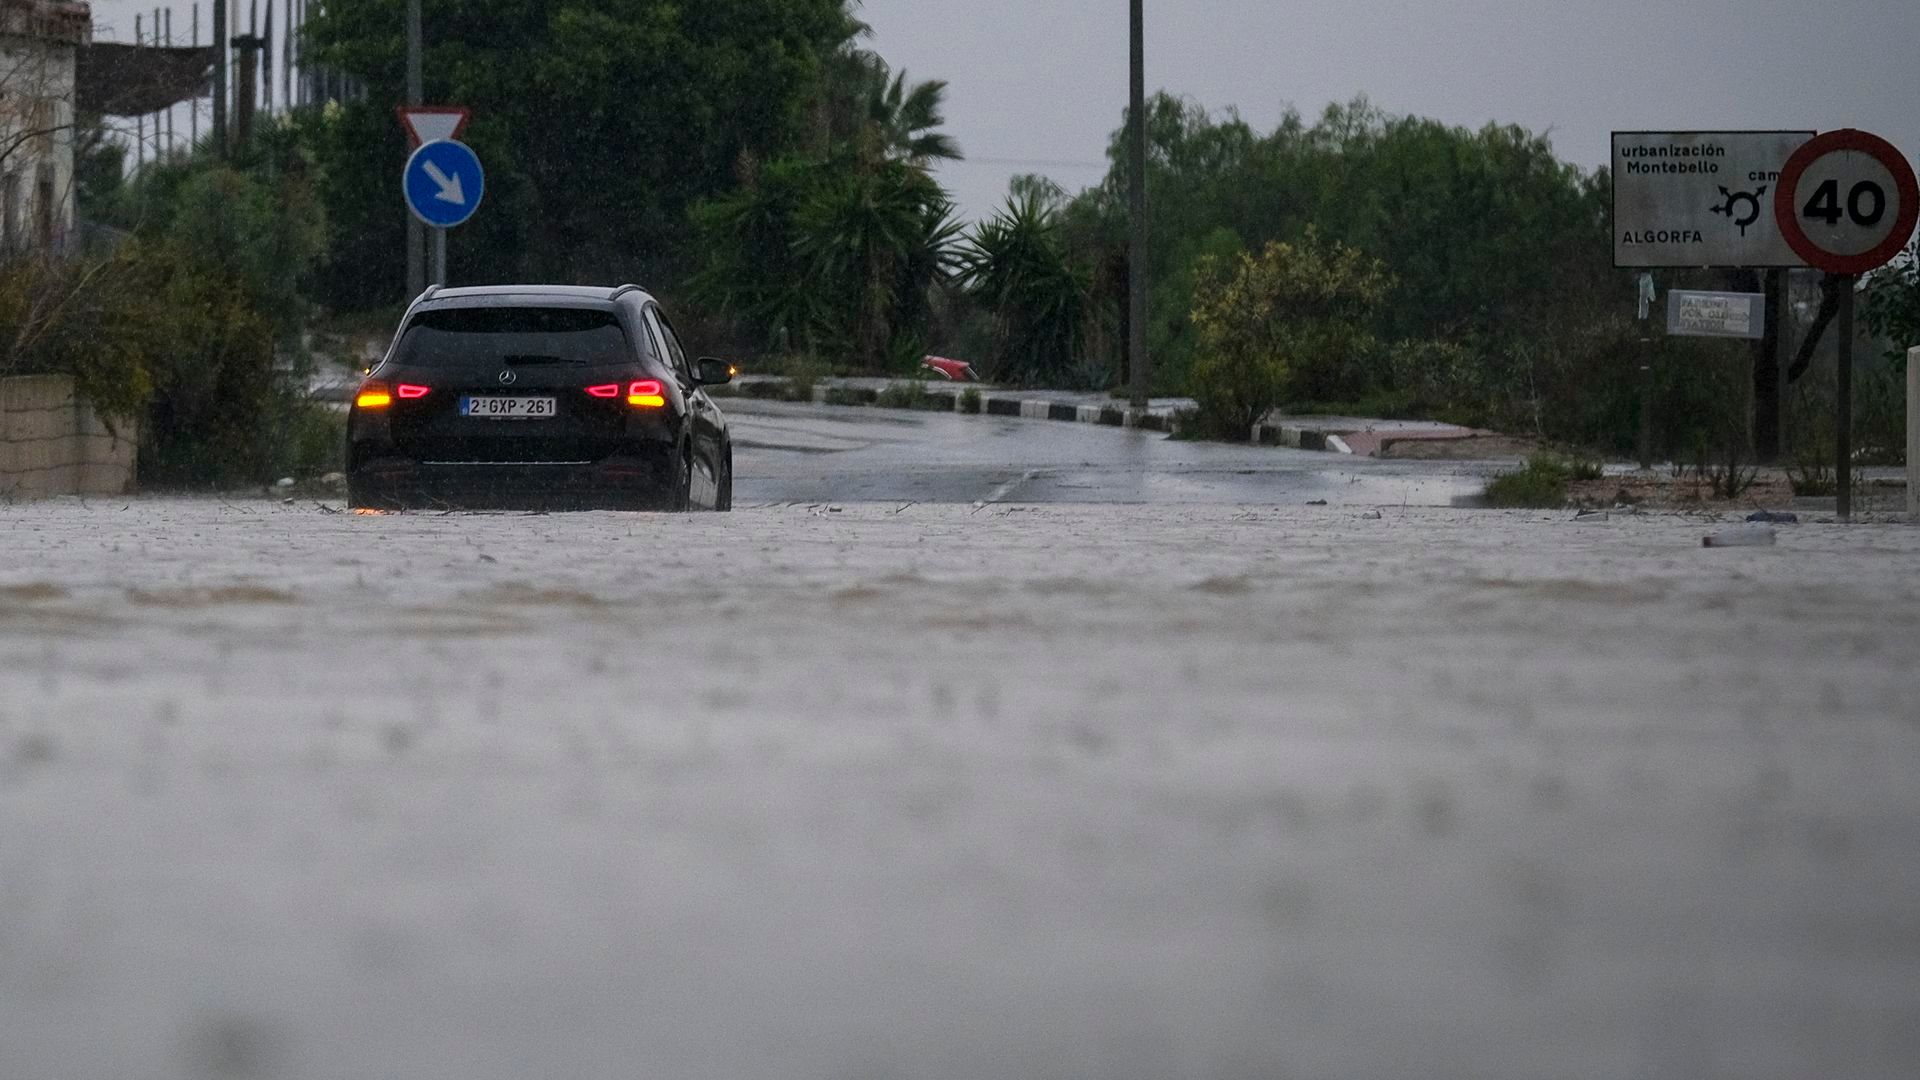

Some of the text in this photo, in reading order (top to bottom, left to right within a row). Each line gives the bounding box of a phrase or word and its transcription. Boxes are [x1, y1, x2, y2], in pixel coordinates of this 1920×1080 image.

[1621, 143, 1725, 157] urbanización
[1627, 161, 1718, 174] Montebello
[1748, 171, 1781, 181] cam
[1803, 179, 1886, 226] 40
[1623, 230, 1703, 243] ALGORFA
